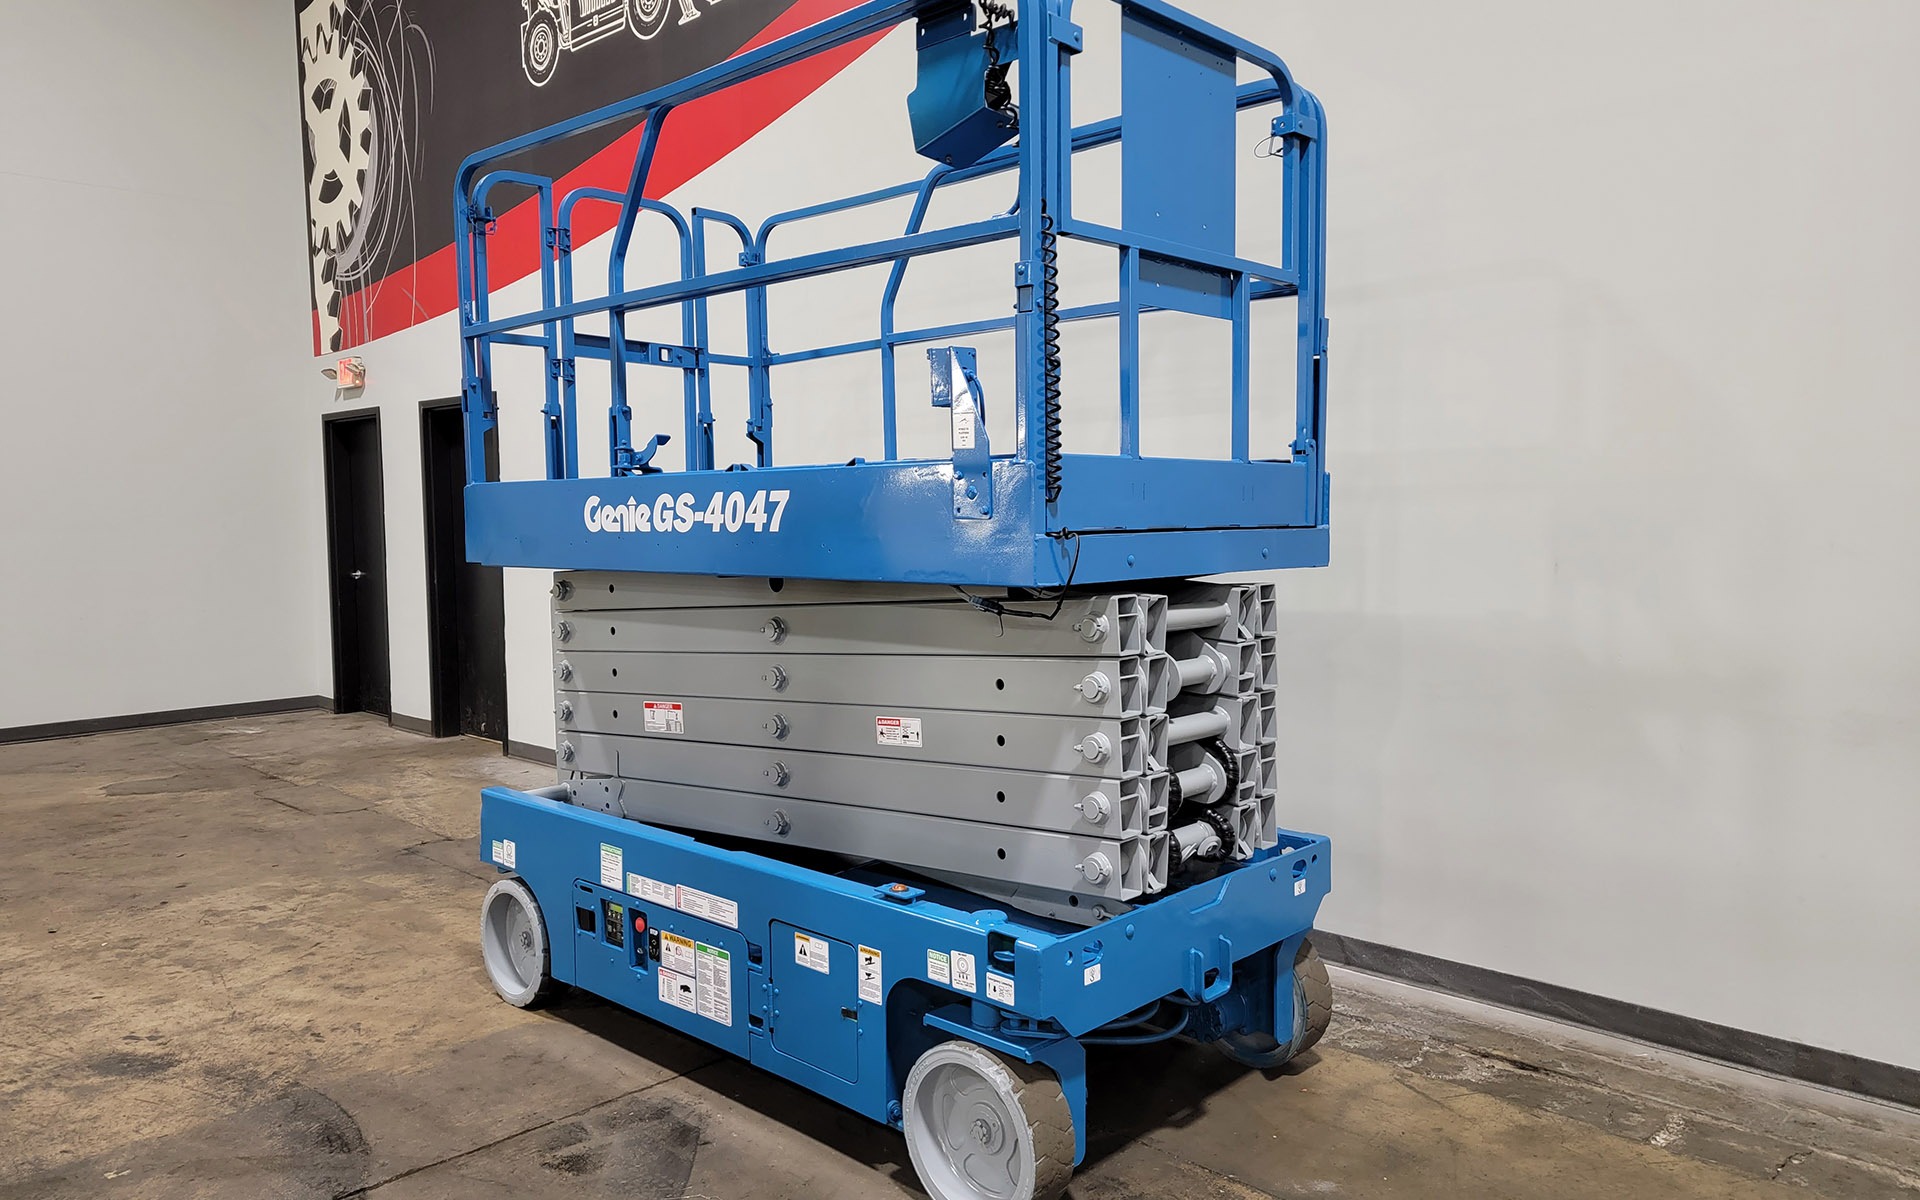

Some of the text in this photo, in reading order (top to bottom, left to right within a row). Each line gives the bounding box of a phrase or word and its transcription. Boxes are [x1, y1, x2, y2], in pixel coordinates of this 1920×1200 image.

[584, 490, 791, 533] Genie GS-4047
[929, 951, 948, 963] NOTICE
